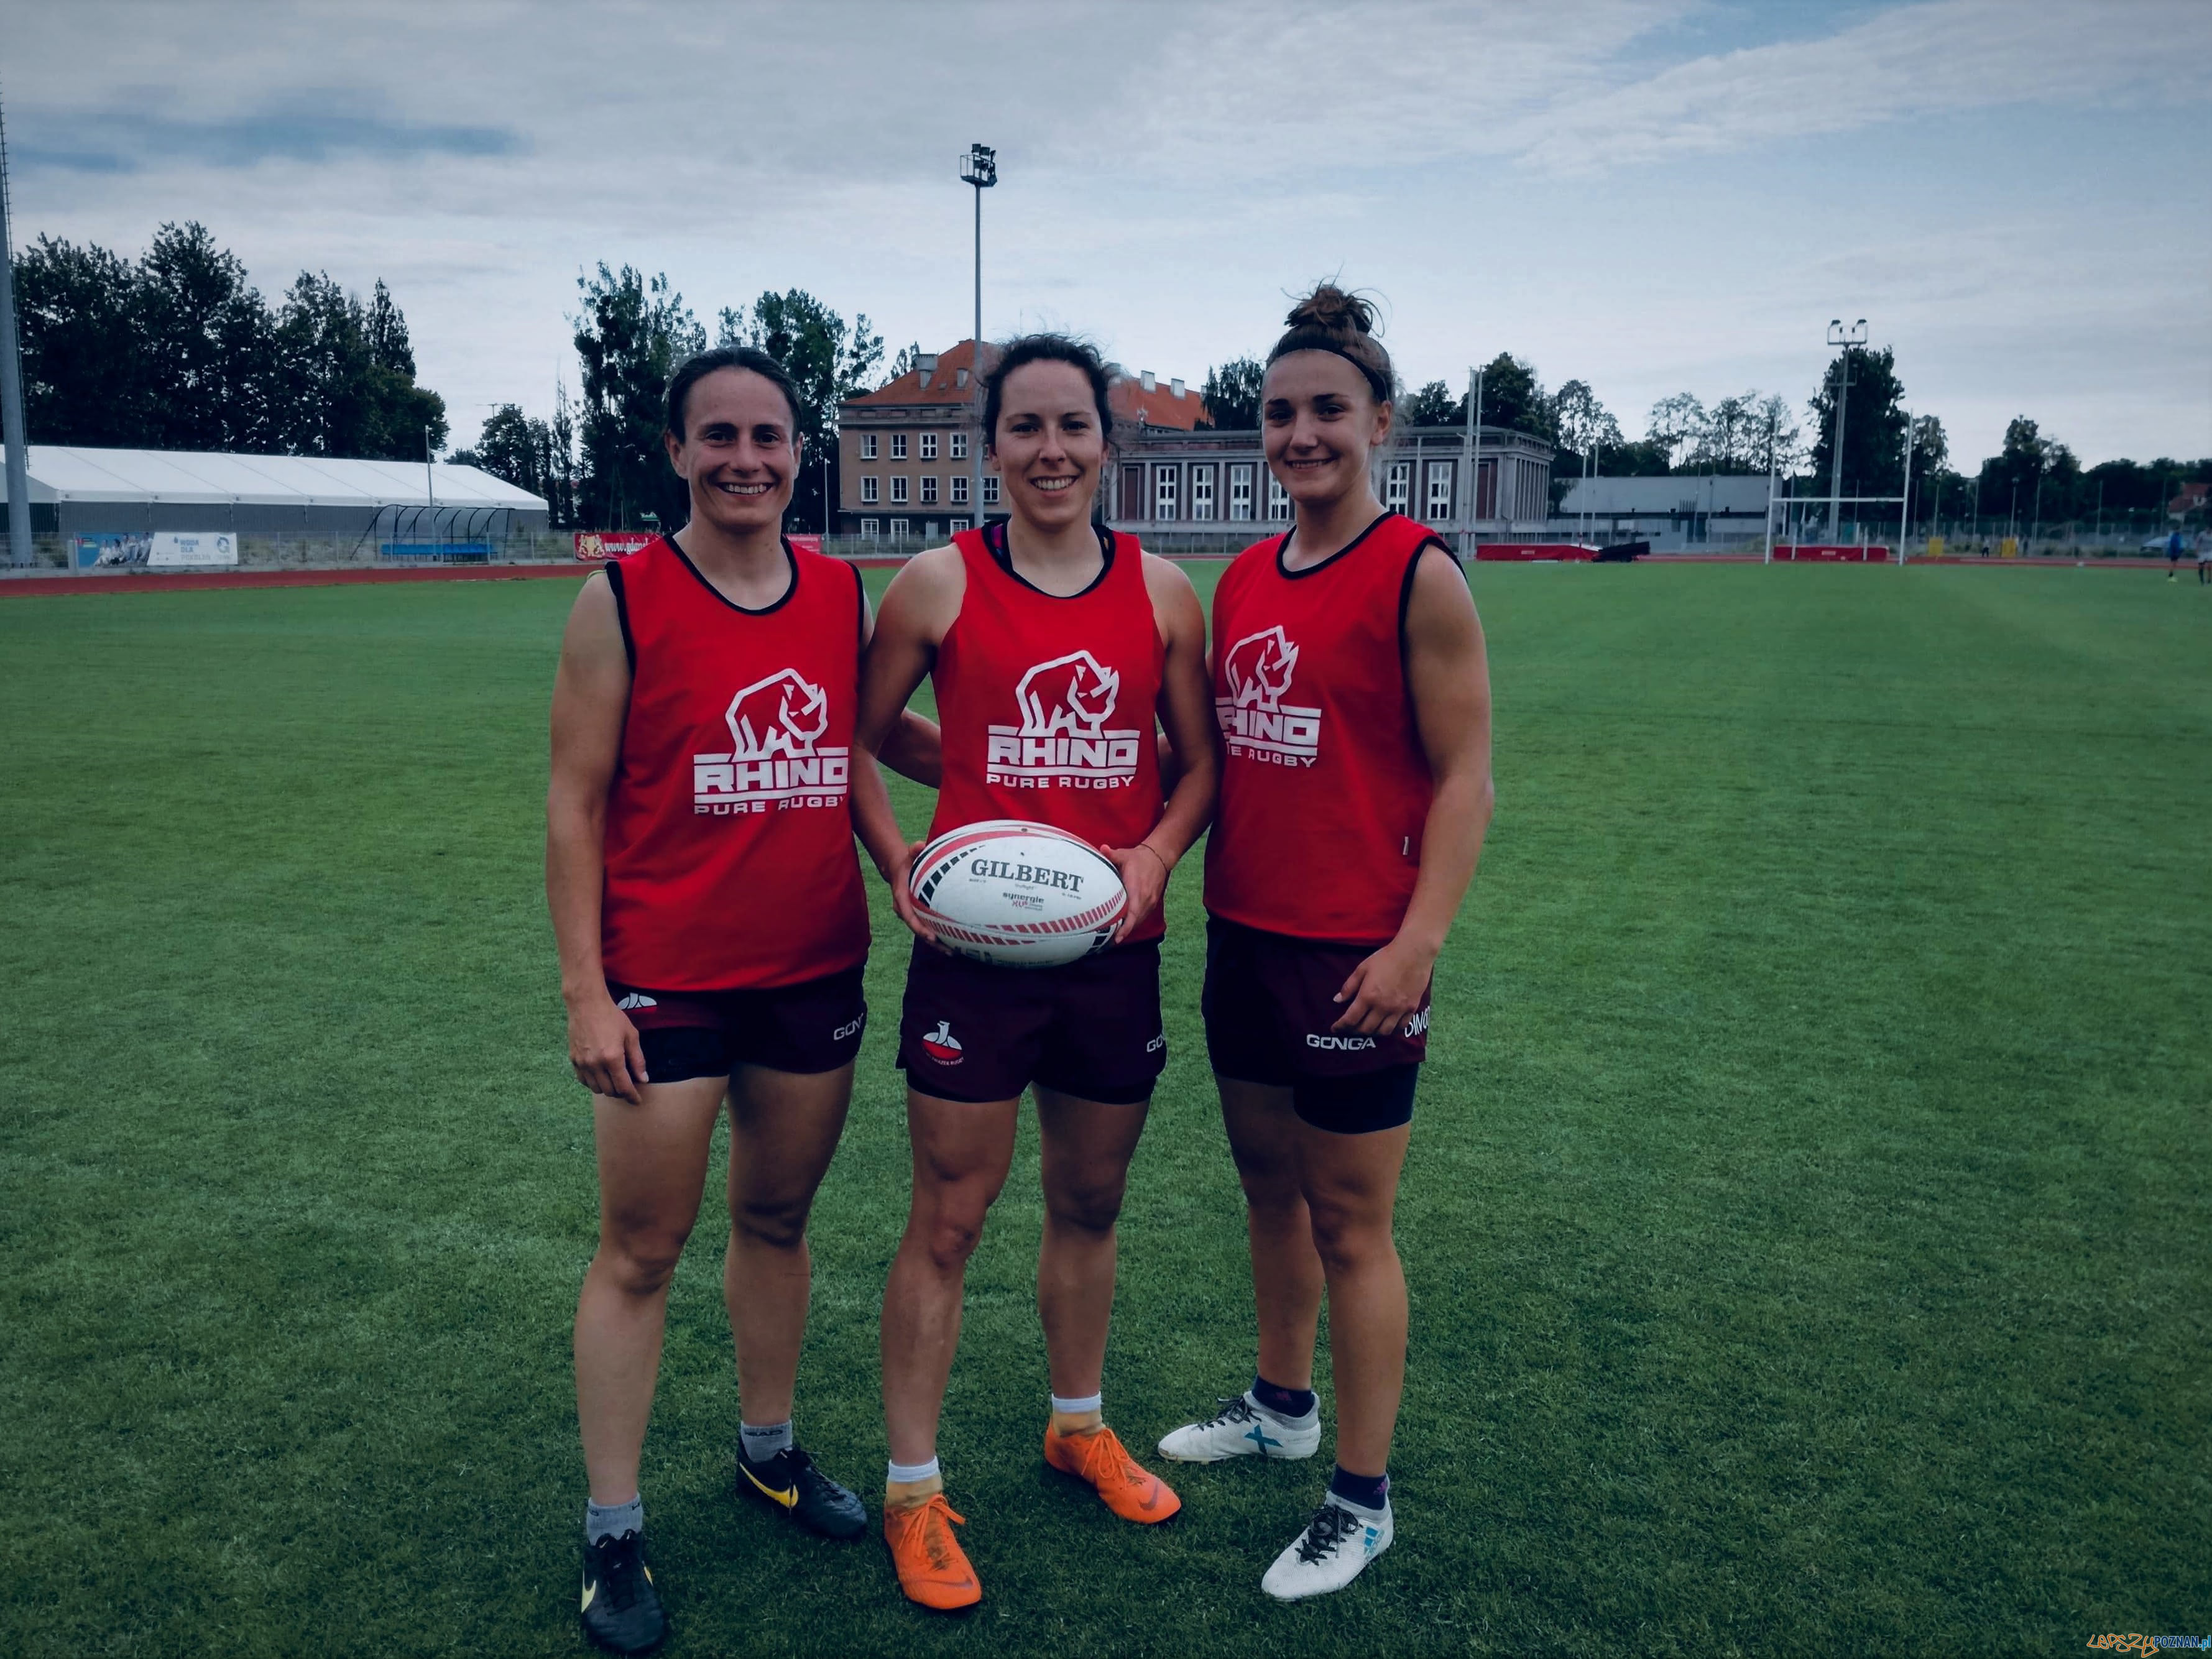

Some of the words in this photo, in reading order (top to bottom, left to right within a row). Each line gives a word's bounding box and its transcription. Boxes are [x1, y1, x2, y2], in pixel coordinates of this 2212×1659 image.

[987, 735, 1139, 767] RHINO
[694, 758, 849, 793] RHINO
[986, 774, 1049, 788] PURE
[1059, 776, 1134, 789] RUGBY
[694, 801, 766, 815] PURE
[971, 858, 1084, 892] GILBERT
